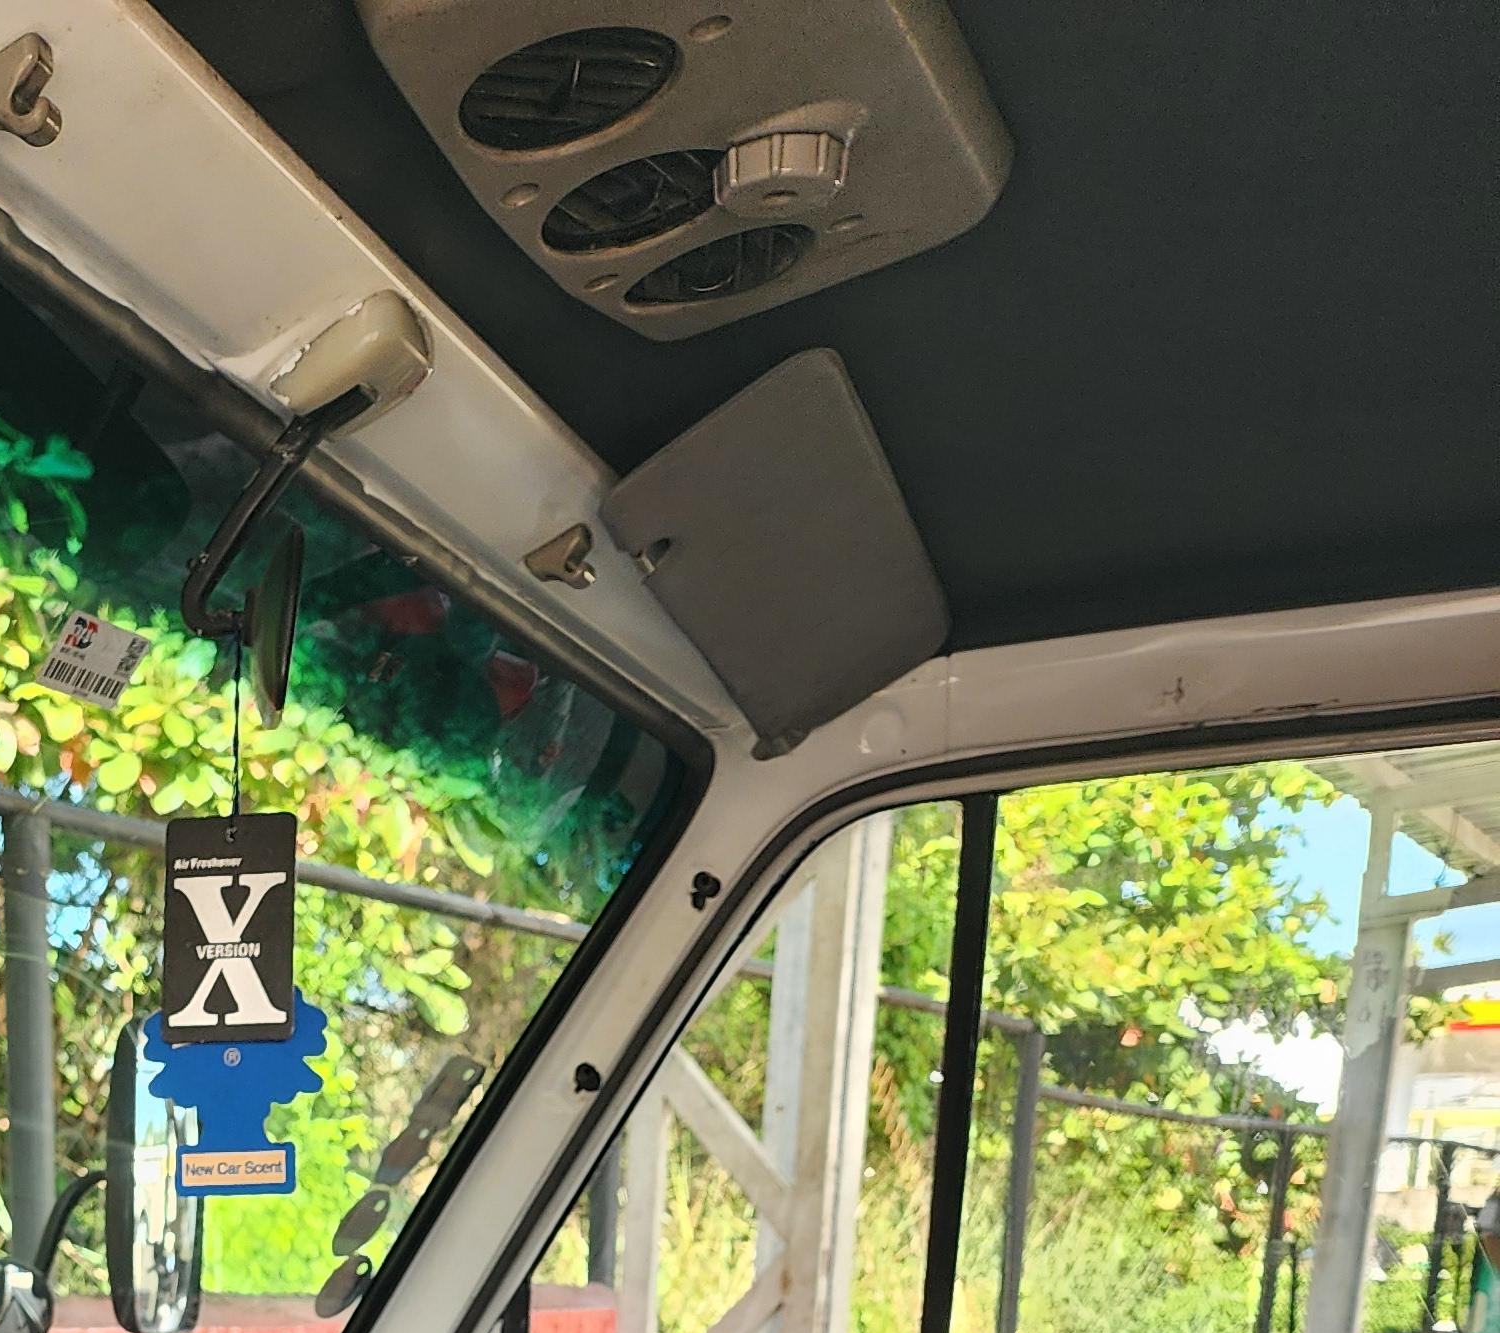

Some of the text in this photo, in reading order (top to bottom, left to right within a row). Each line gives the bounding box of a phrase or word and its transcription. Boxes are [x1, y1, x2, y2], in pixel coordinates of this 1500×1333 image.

[167, 871, 288, 1028] X
[195, 942, 261, 960] VERSION
[186, 1159, 283, 1177] New Car Scent
